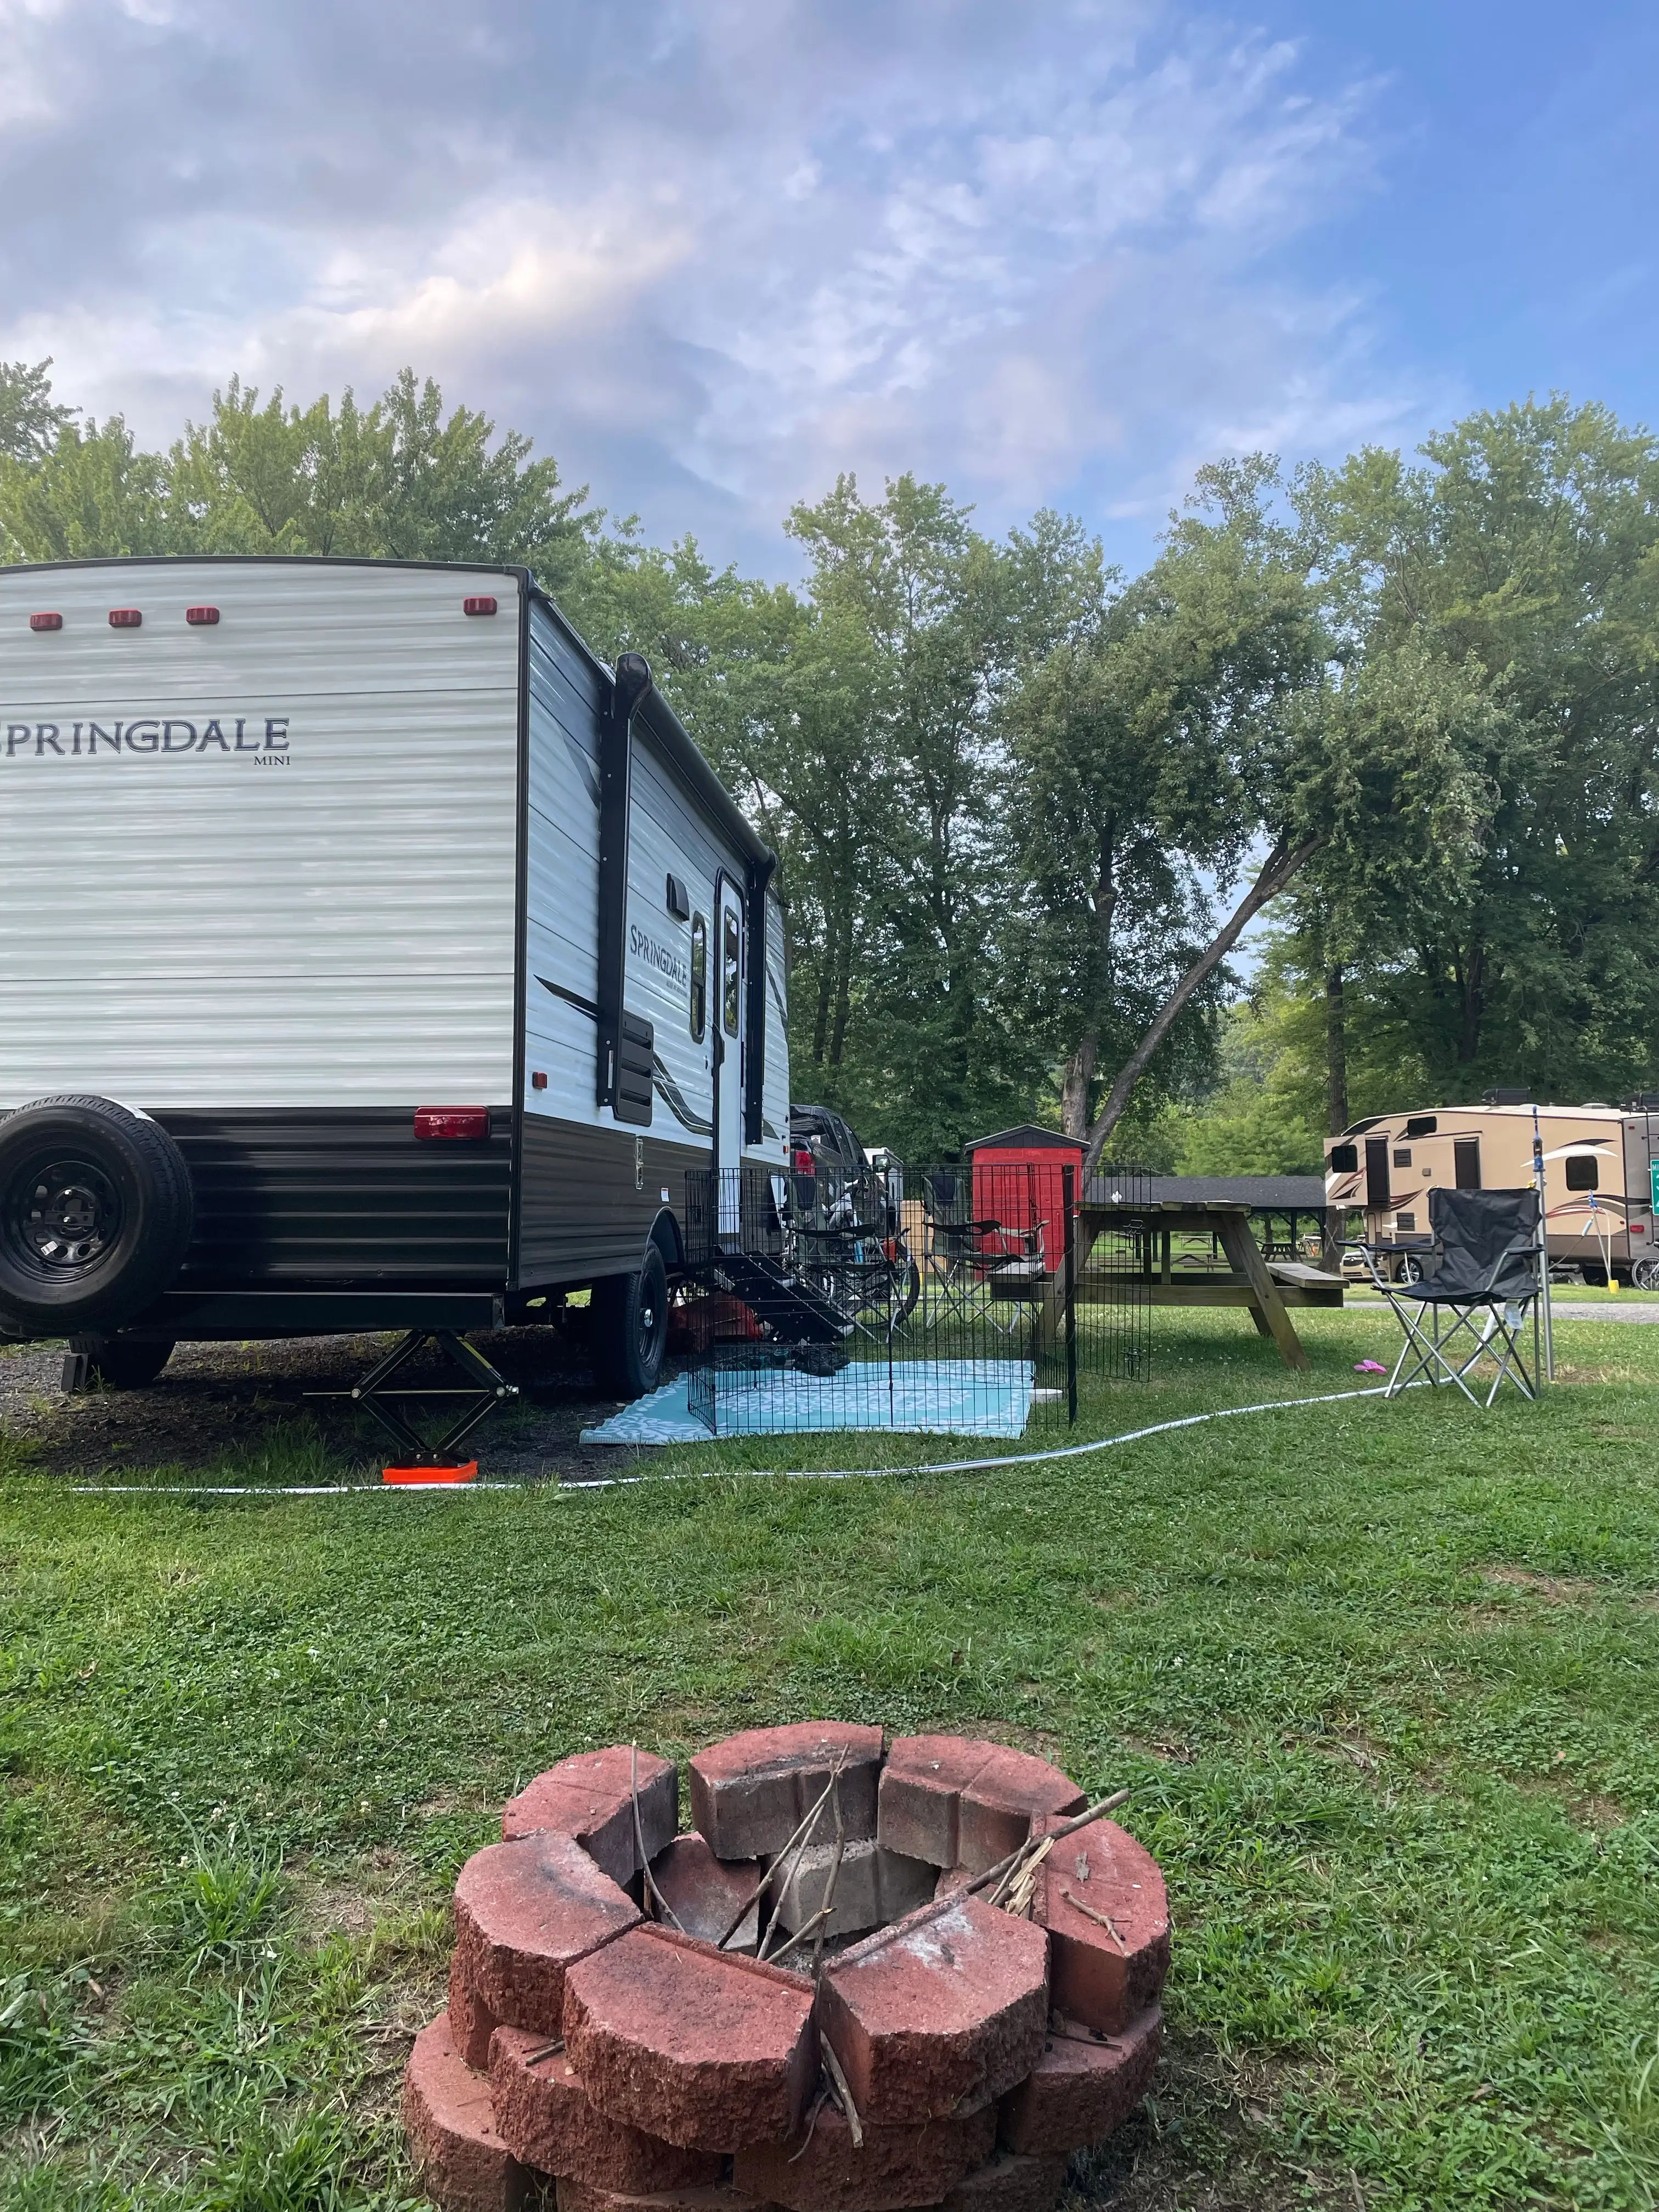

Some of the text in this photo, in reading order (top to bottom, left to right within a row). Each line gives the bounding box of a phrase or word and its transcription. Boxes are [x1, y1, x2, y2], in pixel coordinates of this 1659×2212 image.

[0, 718, 290, 757] PRINGDALE
[253, 756, 290, 765] MINI
[630, 924, 687, 986] SPRINGDALE
